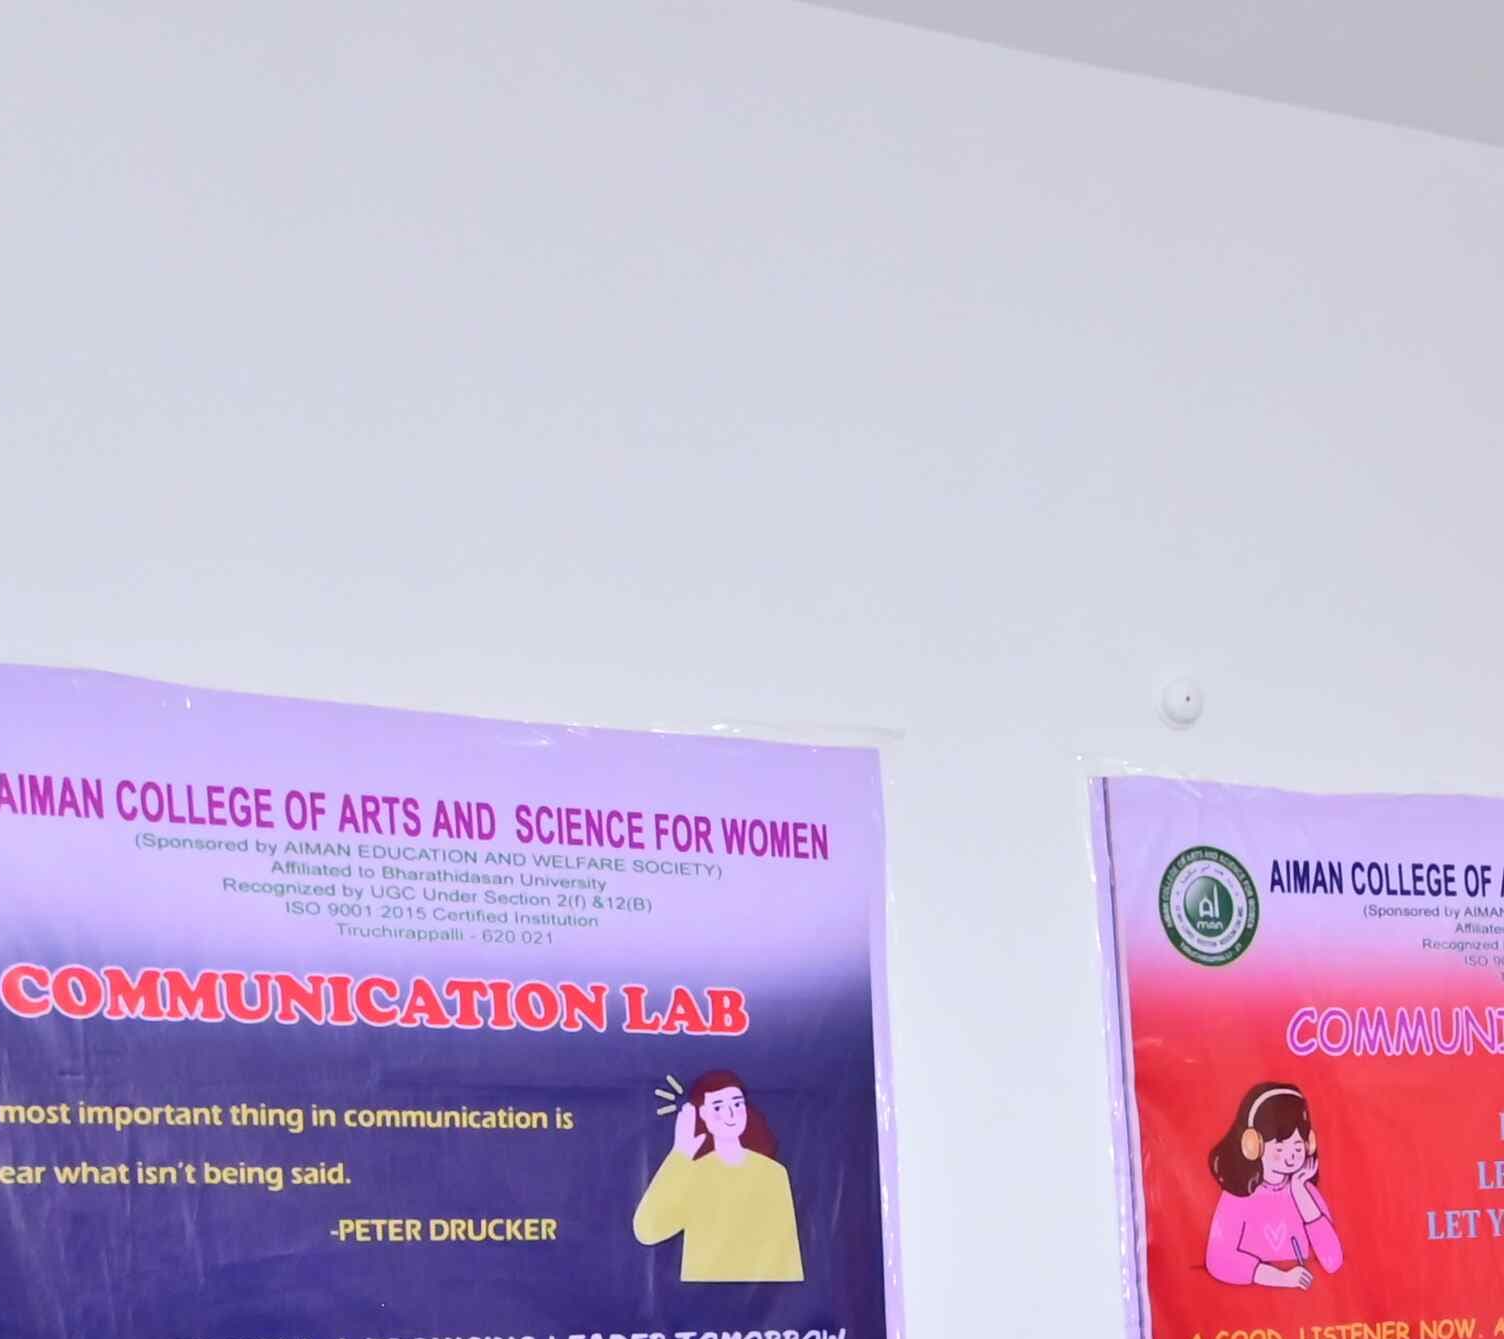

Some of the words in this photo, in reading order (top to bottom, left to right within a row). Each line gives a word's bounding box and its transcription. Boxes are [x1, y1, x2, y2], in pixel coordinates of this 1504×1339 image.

[116, 779, 274, 829] COLLEGE
[285, 790, 326, 832] OF
[338, 793, 422, 838] ARTS
[433, 800, 496, 840] AND
[515, 804, 645, 850] SCIENCE
[655, 813, 714, 854] FOR
[721, 817, 829, 860] WOMEN
[136, 832, 249, 854] (Sponsored
[255, 839, 279, 856] by
[284, 840, 351, 858] AIMAN
[358, 844, 478, 866] EDUCATION
[484, 851, 527, 867] AND
[533, 854, 626, 873] WELFARE
[632, 859, 722, 881] SOCIETY)
[271, 860, 351, 879] Affiliated
[358, 865, 375, 879] to
[382, 864, 514, 886] Bharathidasan
[520, 873, 607, 892] University
[1269, 858, 1344, 896] AIMAN
[1350, 864, 1457, 899] COLLEGE
[1463, 865, 1493, 899] OF
[223, 878, 336, 899] Recognized
[342, 884, 364, 900] by
[370, 885, 416, 900] UGC
[423, 889, 477, 904] Under
[484, 890, 551, 908] Section
[557, 893, 586, 911] 2(f)
[285, 902, 320, 917] ISO
[433, 907, 509, 925] Certified
[514, 911, 599, 928] Institution
[482, 929, 516, 944] 620
[521, 930, 554, 945] 021
[620, 981, 751, 1036] LAB
[78, 1099, 222, 1135] important
[228, 1101, 306, 1135] thing
[312, 1103, 337, 1131] in
[343, 1103, 548, 1133] communication
[553, 1105, 574, 1133] is
[52, 1159, 130, 1187] what
[202, 1159, 284, 1193] being
[290, 1159, 353, 1187] said.
[329, 1217, 424, 1244] -PETER
[428, 1217, 558, 1244] DRUCKER
[1426, 1209, 1479, 1240] LET
